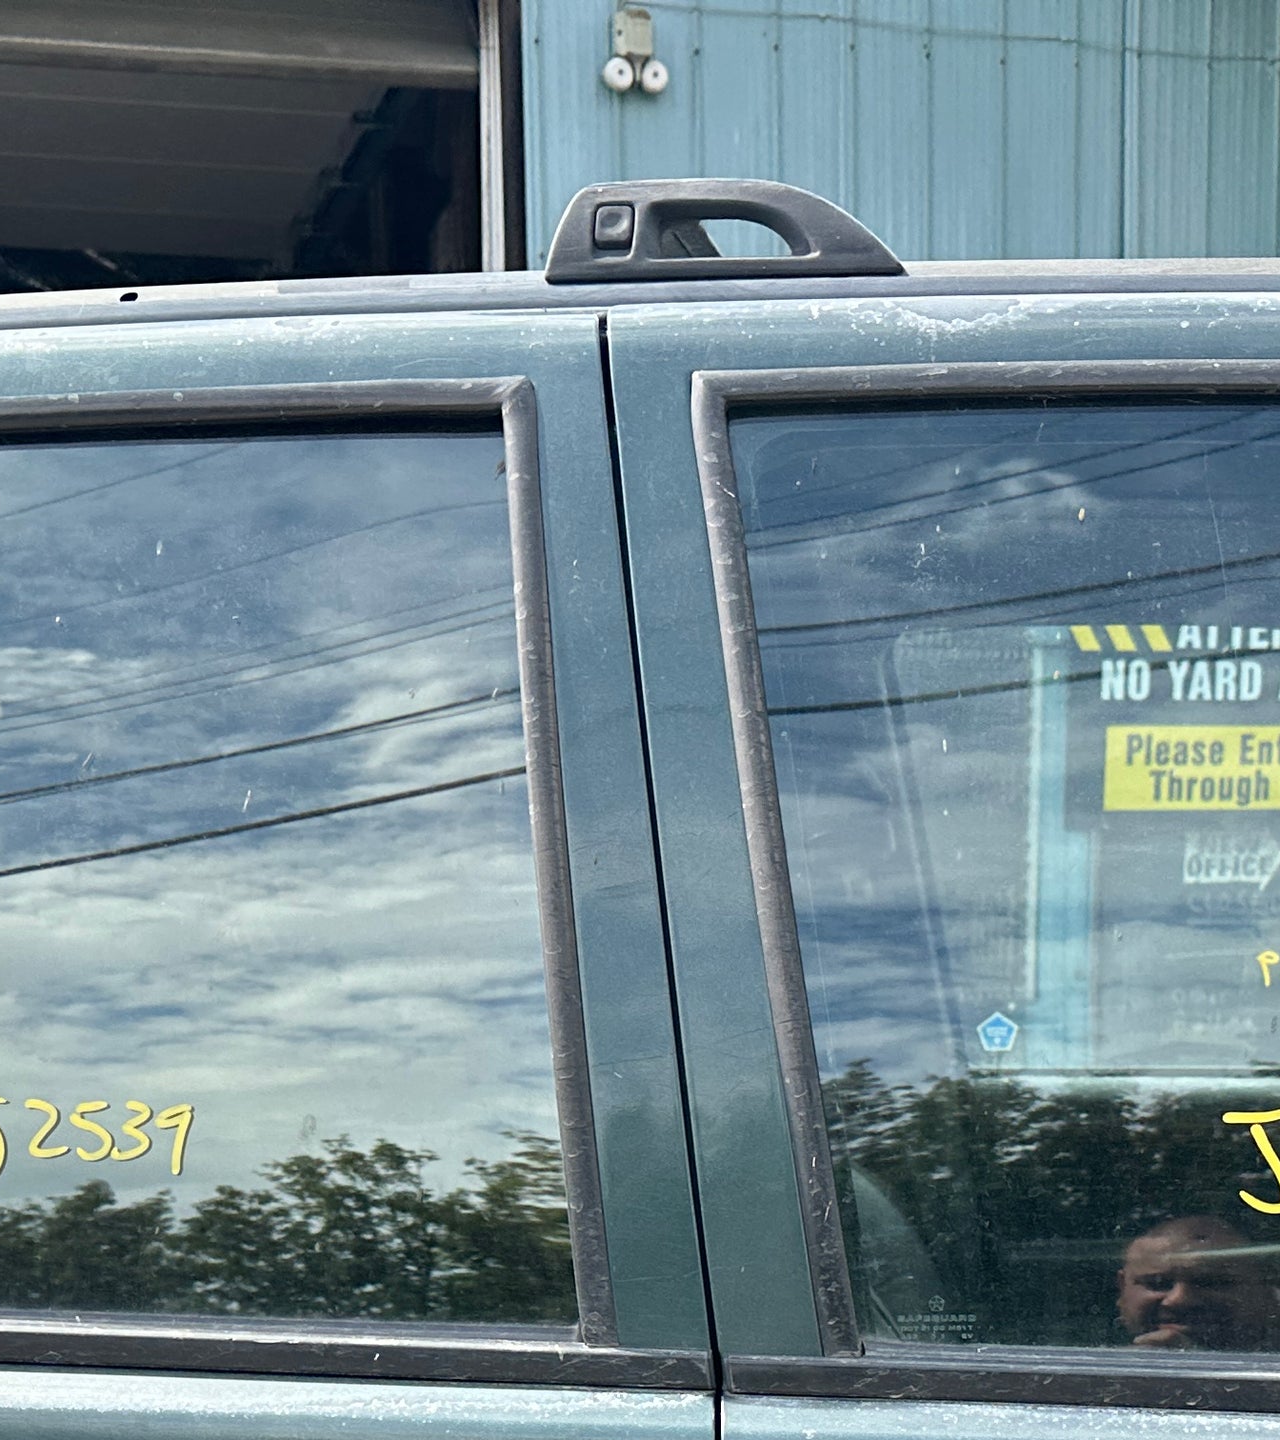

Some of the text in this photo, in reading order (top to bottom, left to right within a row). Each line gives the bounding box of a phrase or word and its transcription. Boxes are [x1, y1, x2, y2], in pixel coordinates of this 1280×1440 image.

[1100, 658, 1152, 702] NO
[1169, 659, 1262, 702] YARD
[1125, 733, 1225, 766] Please
[1150, 770, 1270, 806] Through
[1184, 850, 1273, 879] OFFICE
